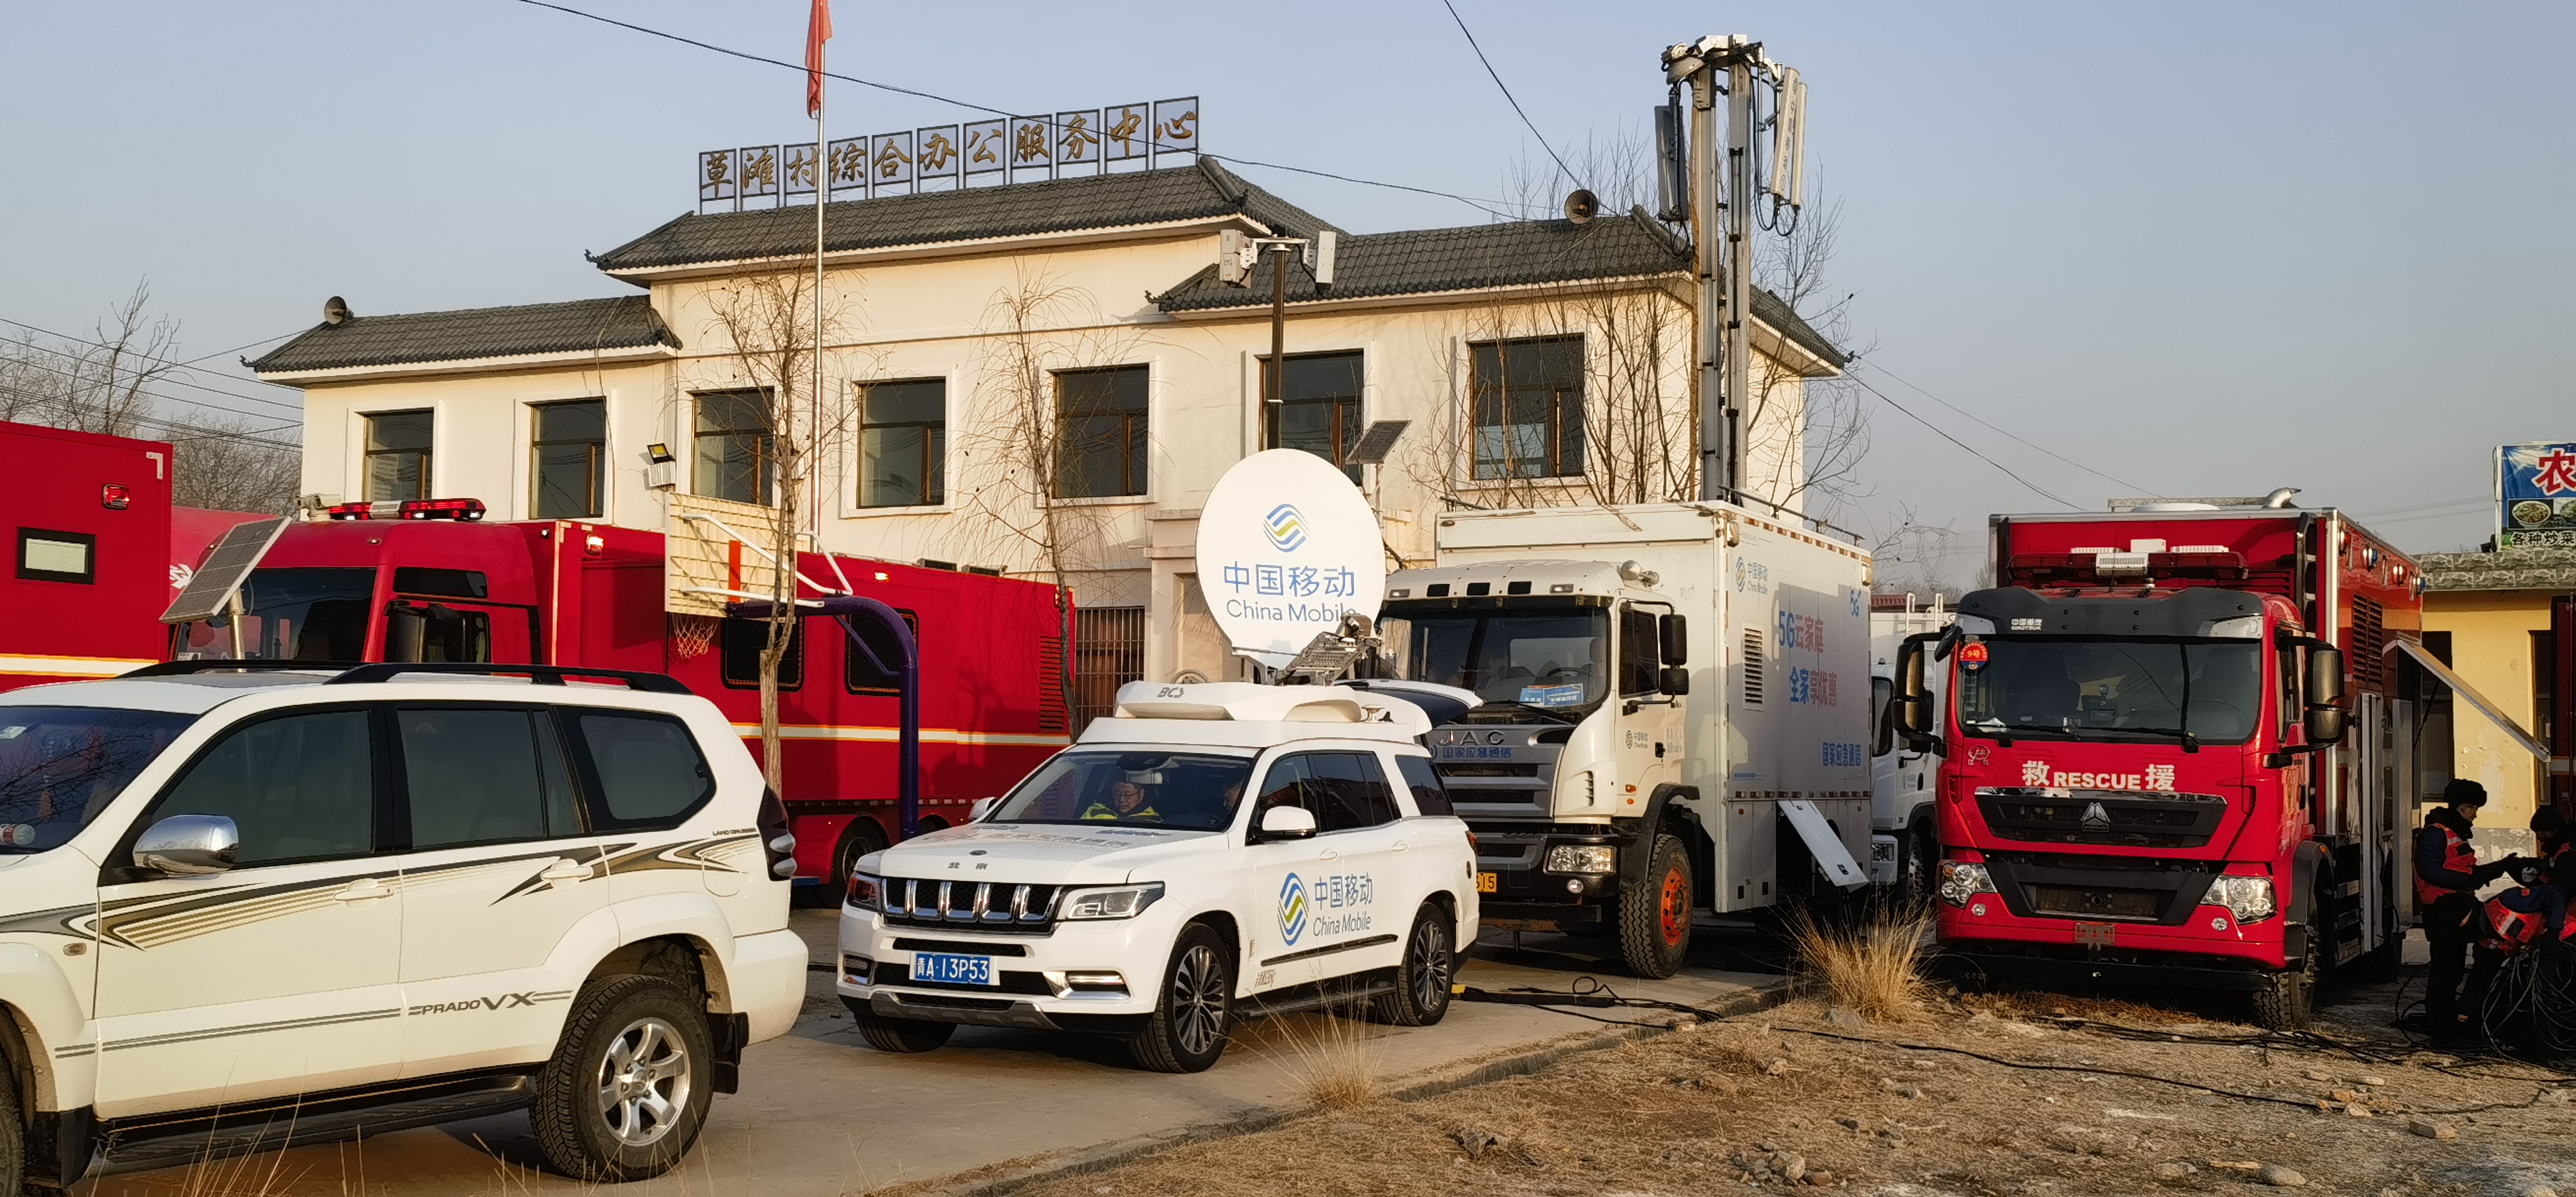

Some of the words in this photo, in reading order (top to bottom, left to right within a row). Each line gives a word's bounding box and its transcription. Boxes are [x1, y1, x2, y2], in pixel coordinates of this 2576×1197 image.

[701, 108, 1196, 198] 草滩村综合办公服务中心
[2532, 448, 2576, 494] 农
[2511, 532, 2576, 546] 各种炒菜
[1224, 561, 1355, 598] 中国移动
[1226, 599, 1282, 621] China
[1779, 610, 1824, 653] 5G云家庭
[1789, 666, 1838, 707] 全家享优惠
[1437, 730, 1505, 746] JAC
[2021, 760, 2051, 786] 救
[2053, 771, 2141, 790] RESCUE
[2145, 764, 2175, 792] 援
[1314, 872, 1373, 910] 中国移动
[1313, 917, 1340, 937] China
[1341, 911, 1371, 933] Mobile
[421, 1000, 480, 1015] PRADO
[480, 991, 536, 1010] VX
